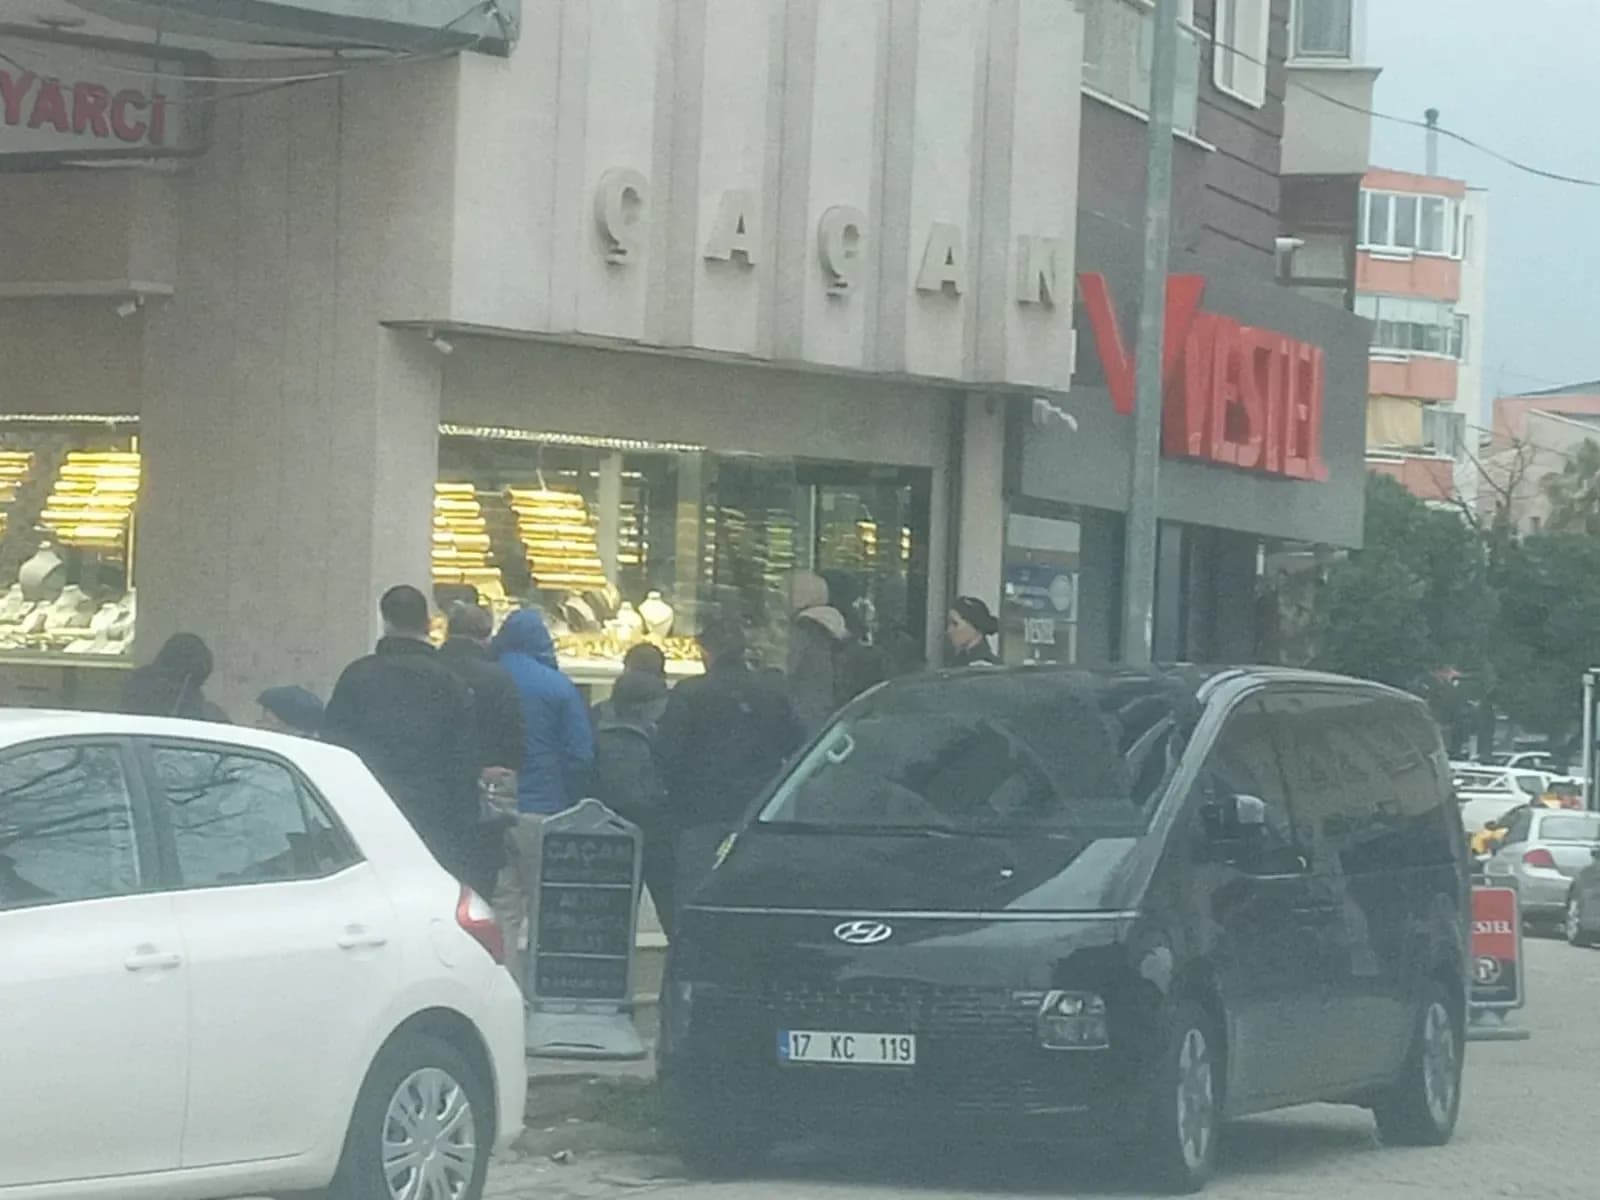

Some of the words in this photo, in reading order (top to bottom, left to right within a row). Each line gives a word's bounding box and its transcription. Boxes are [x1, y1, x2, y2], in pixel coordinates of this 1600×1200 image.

[594, 166, 1059, 306] ÇAÇAN
[792, 1034, 811, 1057] 17
[831, 1035, 855, 1059] KC
[880, 1037, 911, 1061] 119
